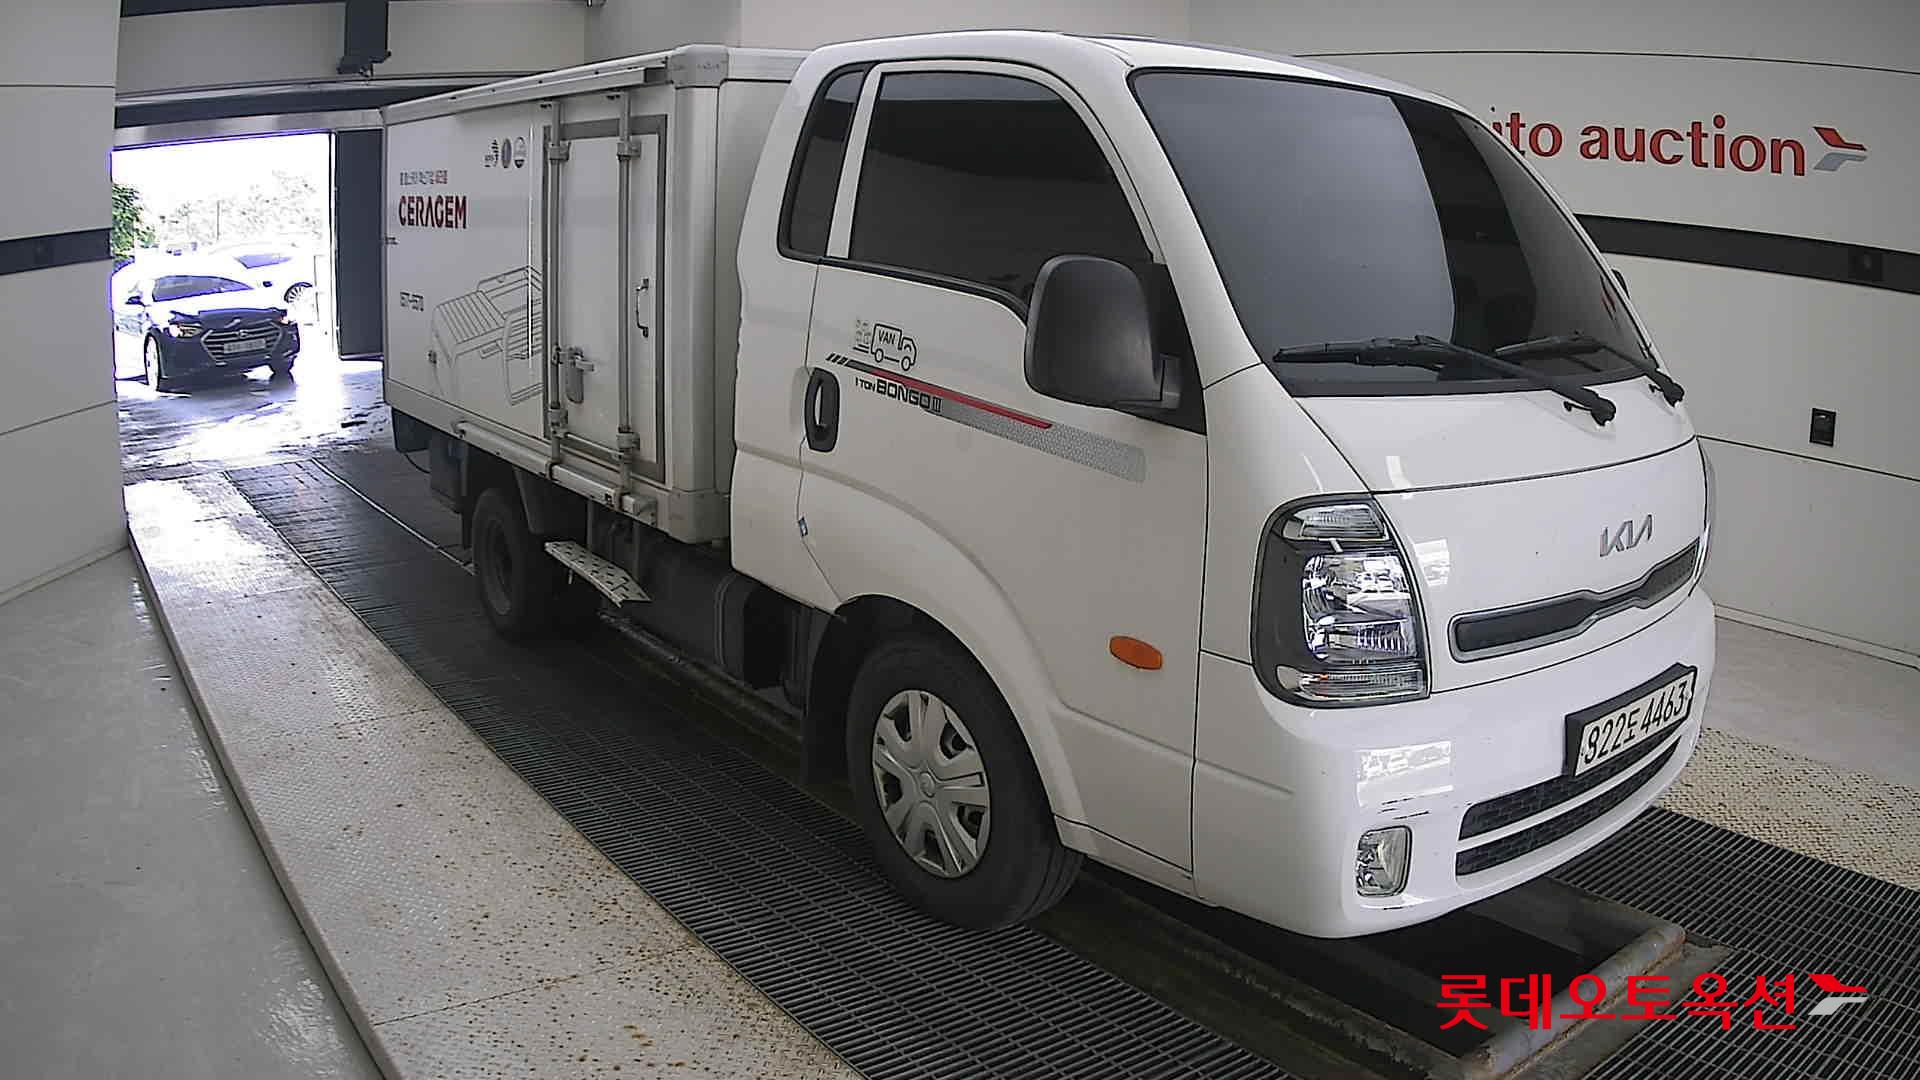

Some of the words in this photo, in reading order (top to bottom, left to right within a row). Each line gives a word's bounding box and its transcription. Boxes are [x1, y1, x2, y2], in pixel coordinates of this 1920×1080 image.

[1491, 112, 1562, 157] to
[1580, 114, 1806, 177] auction
[398, 195, 467, 229] CERAGEM
[878, 329, 897, 346] VAN
[876, 378, 931, 409] BONGO
[1600, 514, 1652, 557] KIA
